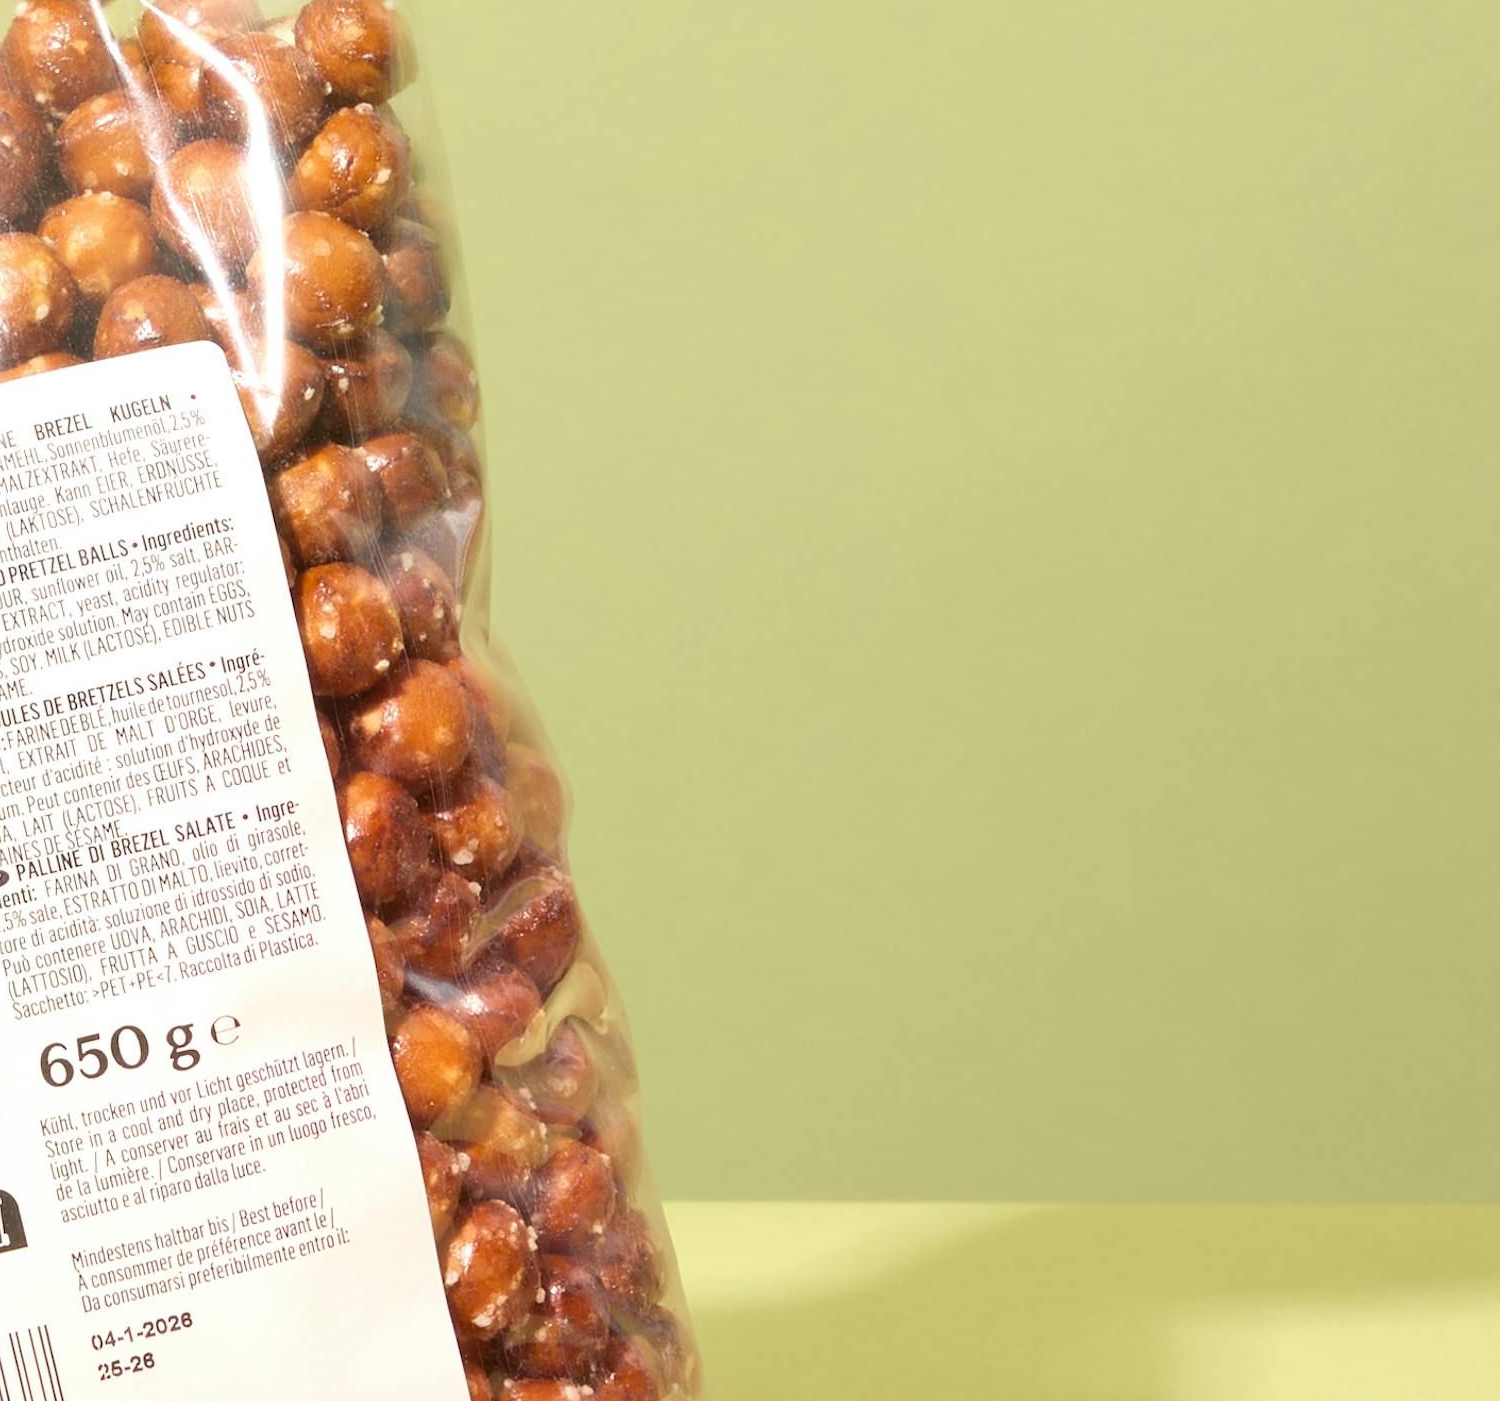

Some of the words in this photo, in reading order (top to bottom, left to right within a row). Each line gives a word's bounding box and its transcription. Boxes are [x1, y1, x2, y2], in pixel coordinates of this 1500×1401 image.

[33, 413, 93, 442] BREZEL
[109, 394, 172, 424] KUGELN
[7, 553, 77, 584] PRETZEL
[77, 538, 129, 567] BALLS
[141, 517, 234, 552] Ingredients:
[42, 696, 65, 717] DE
[66, 676, 145, 712] BRETZELS
[146, 661, 207, 692] SALÉES
[220, 647, 265, 675] Ingré-
[14, 845, 83, 882] PALLINE
[86, 840, 106, 864] DI
[110, 828, 170, 859] BREZEL
[174, 811, 236, 843] SALATE
[255, 800, 299, 823] Ingre-
[12, 982, 89, 1021] Sacchetto:
[178, 951, 242, 980] Raccolta
[243, 943, 258, 964] di
[258, 933, 319, 960] Plastica.
[39, 1024, 150, 1088] 650
[39, 1113, 79, 1137] Kühl,
[80, 1101, 136, 1128] trocken
[139, 1090, 167, 1114] und
[169, 1087, 192, 1105] vor
[195, 1075, 234, 1099] Licht
[235, 1055, 301, 1093] geschützt
[301, 1043, 349, 1069] lagern.
[44, 1137, 84, 1159] Store
[87, 1130, 104, 1148] in
[121, 1116, 154, 1140] cool
[157, 1108, 185, 1132] and
[189, 1104, 212, 1124] dry
[217, 1089, 260, 1120] place,
[263, 1067, 328, 1107] protected
[330, 1061, 364, 1083] from
[70, 1238, 153, 1273] Mindestens
[153, 1224, 205, 1250] haltbar
[206, 1216, 230, 1236] bis
[238, 1205, 271, 1228] Best
[271, 1194, 317, 1219] before
[90, 1255, 173, 1289] consommer
[176, 1248, 194, 1268] de
[196, 1229, 272, 1265] préférence
[274, 1216, 313, 1241] avant
[313, 1211, 328, 1230] le
[80, 1294, 102, 1314] Da
[103, 1271, 186, 1308] consumarsi
[187, 1245, 296, 1291] preferibilmente
[298, 1234, 335, 1257] entro
